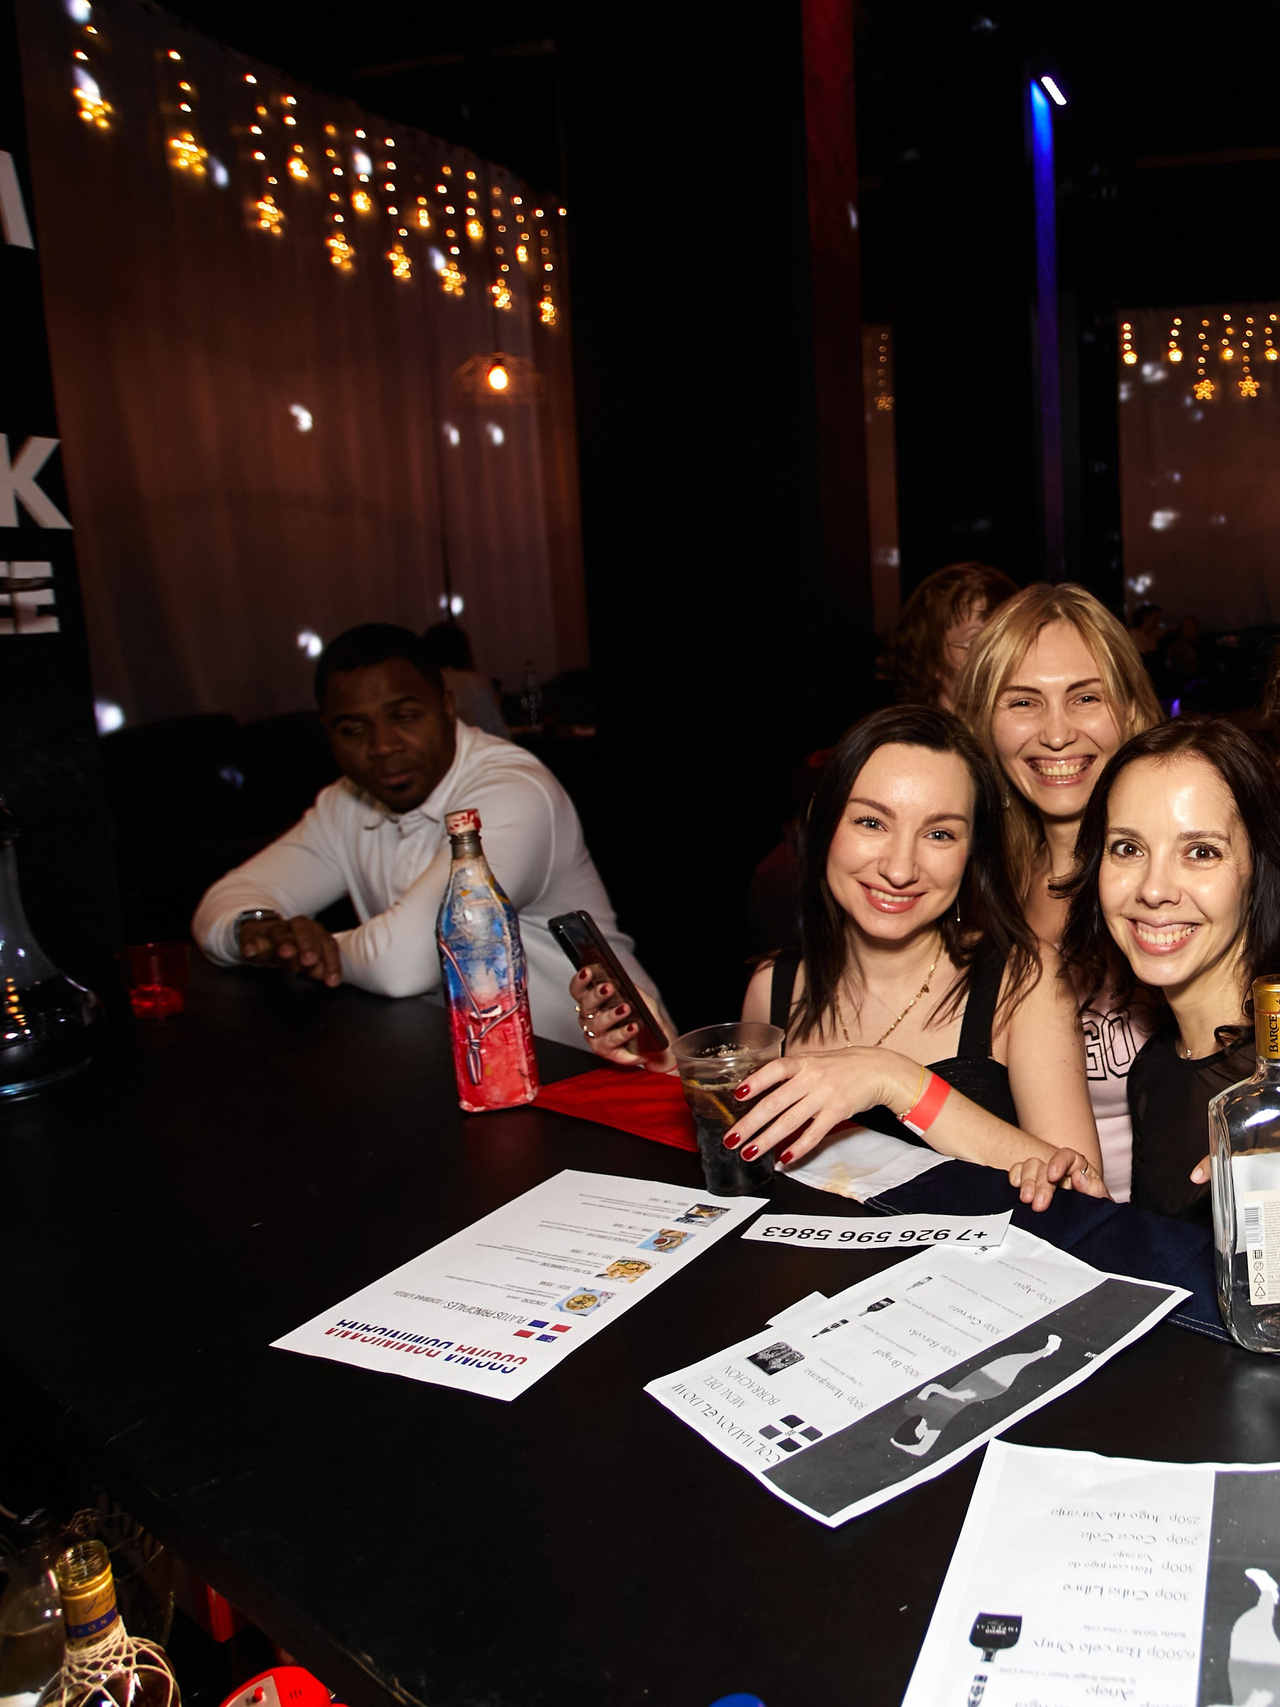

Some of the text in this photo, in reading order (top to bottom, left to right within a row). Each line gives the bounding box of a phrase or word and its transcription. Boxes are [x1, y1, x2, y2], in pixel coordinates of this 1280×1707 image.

[762, 1226, 988, 1244] +7 926 596 5863
[443, 1301, 496, 1319] PRINCIPALES
[493, 1310, 528, 1325] PLATOS
[324, 1318, 528, 1374] COCINA DOMINICANA
[702, 1374, 748, 1408] MENU DEL
[721, 1365, 780, 1406] BORRACHON
[1080, 1531, 1113, 1542] Cola
[1118, 1533, 1156, 1544] Coca
[1108, 1587, 1149, 1601] Cuba
